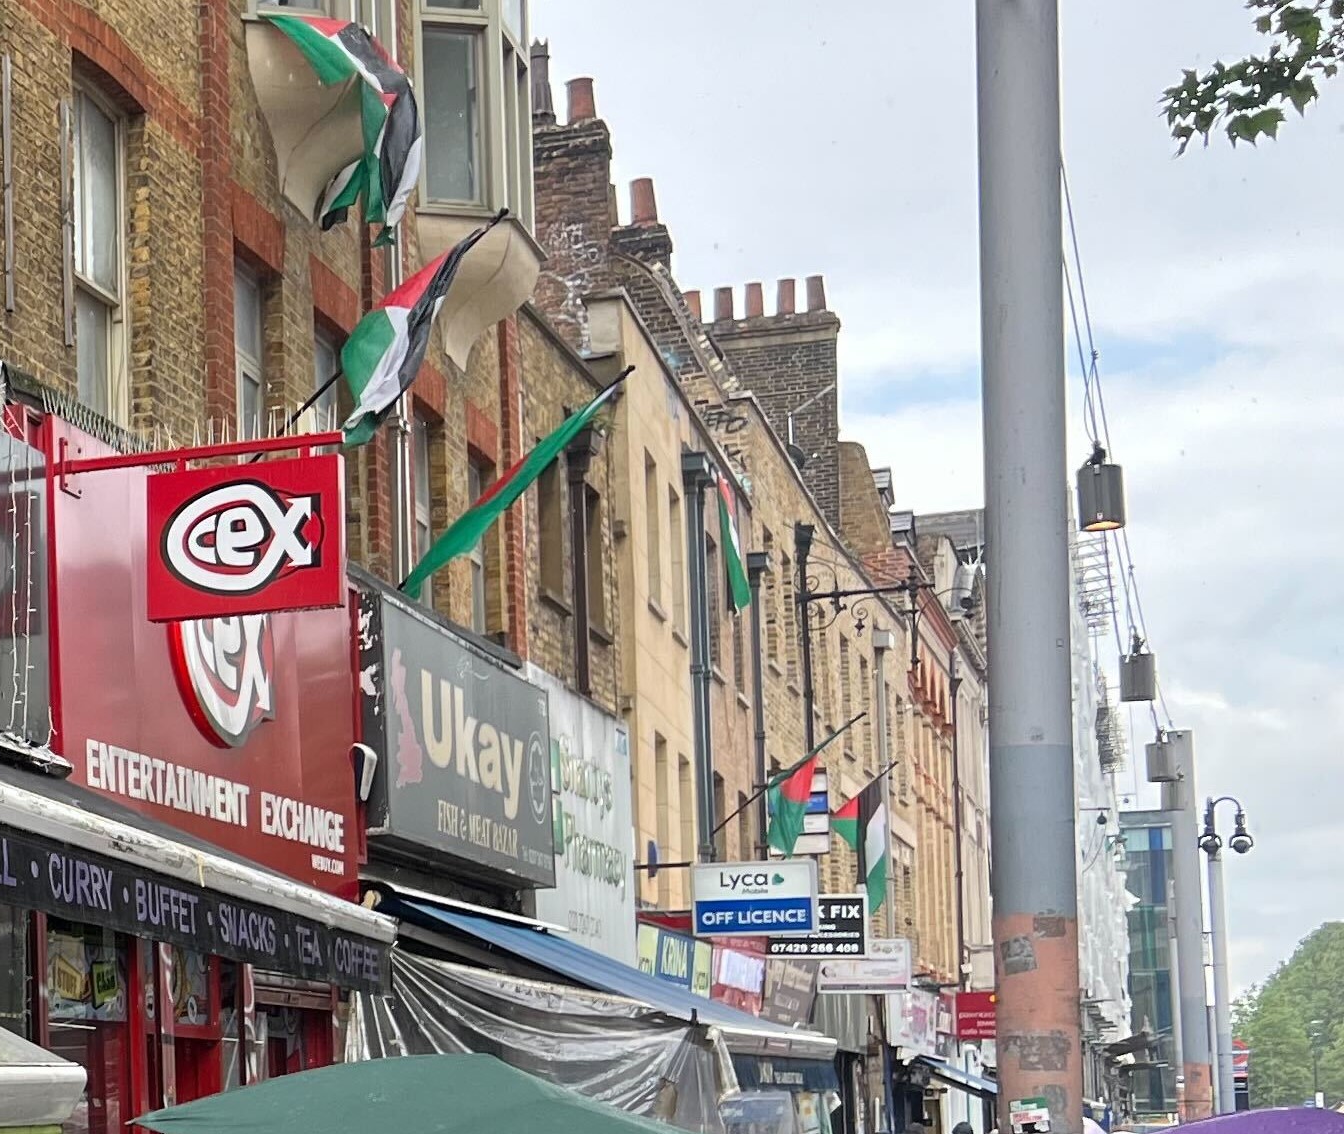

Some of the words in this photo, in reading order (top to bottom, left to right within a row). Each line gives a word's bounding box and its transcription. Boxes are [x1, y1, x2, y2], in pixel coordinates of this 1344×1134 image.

[86, 739, 249, 827] ENTERTAINMENT
[260, 791, 344, 853] EXCHANGE
[421, 668, 524, 820] Ukay
[48, 852, 113, 912] CURRY
[136, 878, 198, 935] BUFFET
[219, 902, 276, 955] SNACKS
[295, 925, 323, 967] TEA
[334, 936, 380, 981] COFFEE
[702, 911, 733, 926] OFF
[738, 908, 806, 924] LICENCE
[719, 871, 768, 889] Lyca
